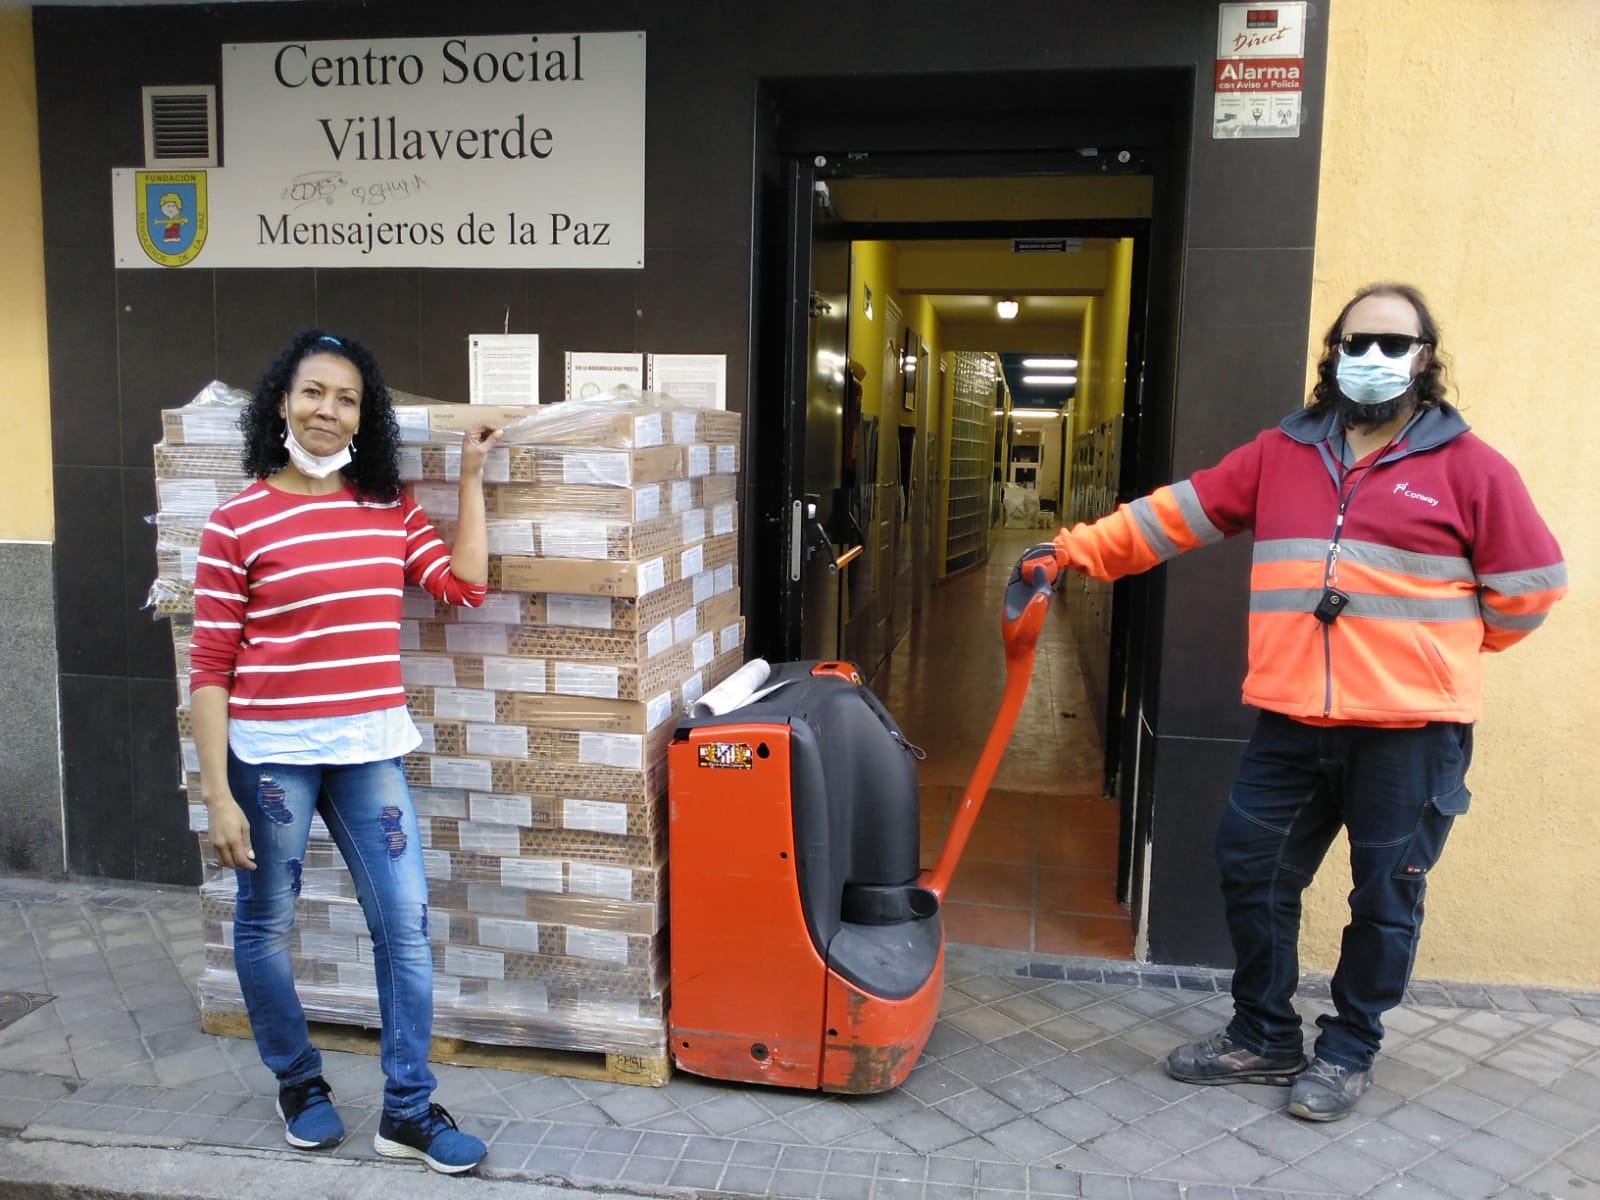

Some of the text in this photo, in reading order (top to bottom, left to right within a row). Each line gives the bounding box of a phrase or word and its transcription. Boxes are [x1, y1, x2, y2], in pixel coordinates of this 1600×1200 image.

[1233, 27, 1291, 52] Direct
[273, 35, 585, 88] Centro Social
[1219, 62, 1300, 81] Alarma
[1219, 81, 1235, 89] con
[1236, 80, 1261, 89] Aviso
[318, 113, 553, 161] Villaverde
[257, 212, 611, 254] Mensajeros de la Paz
